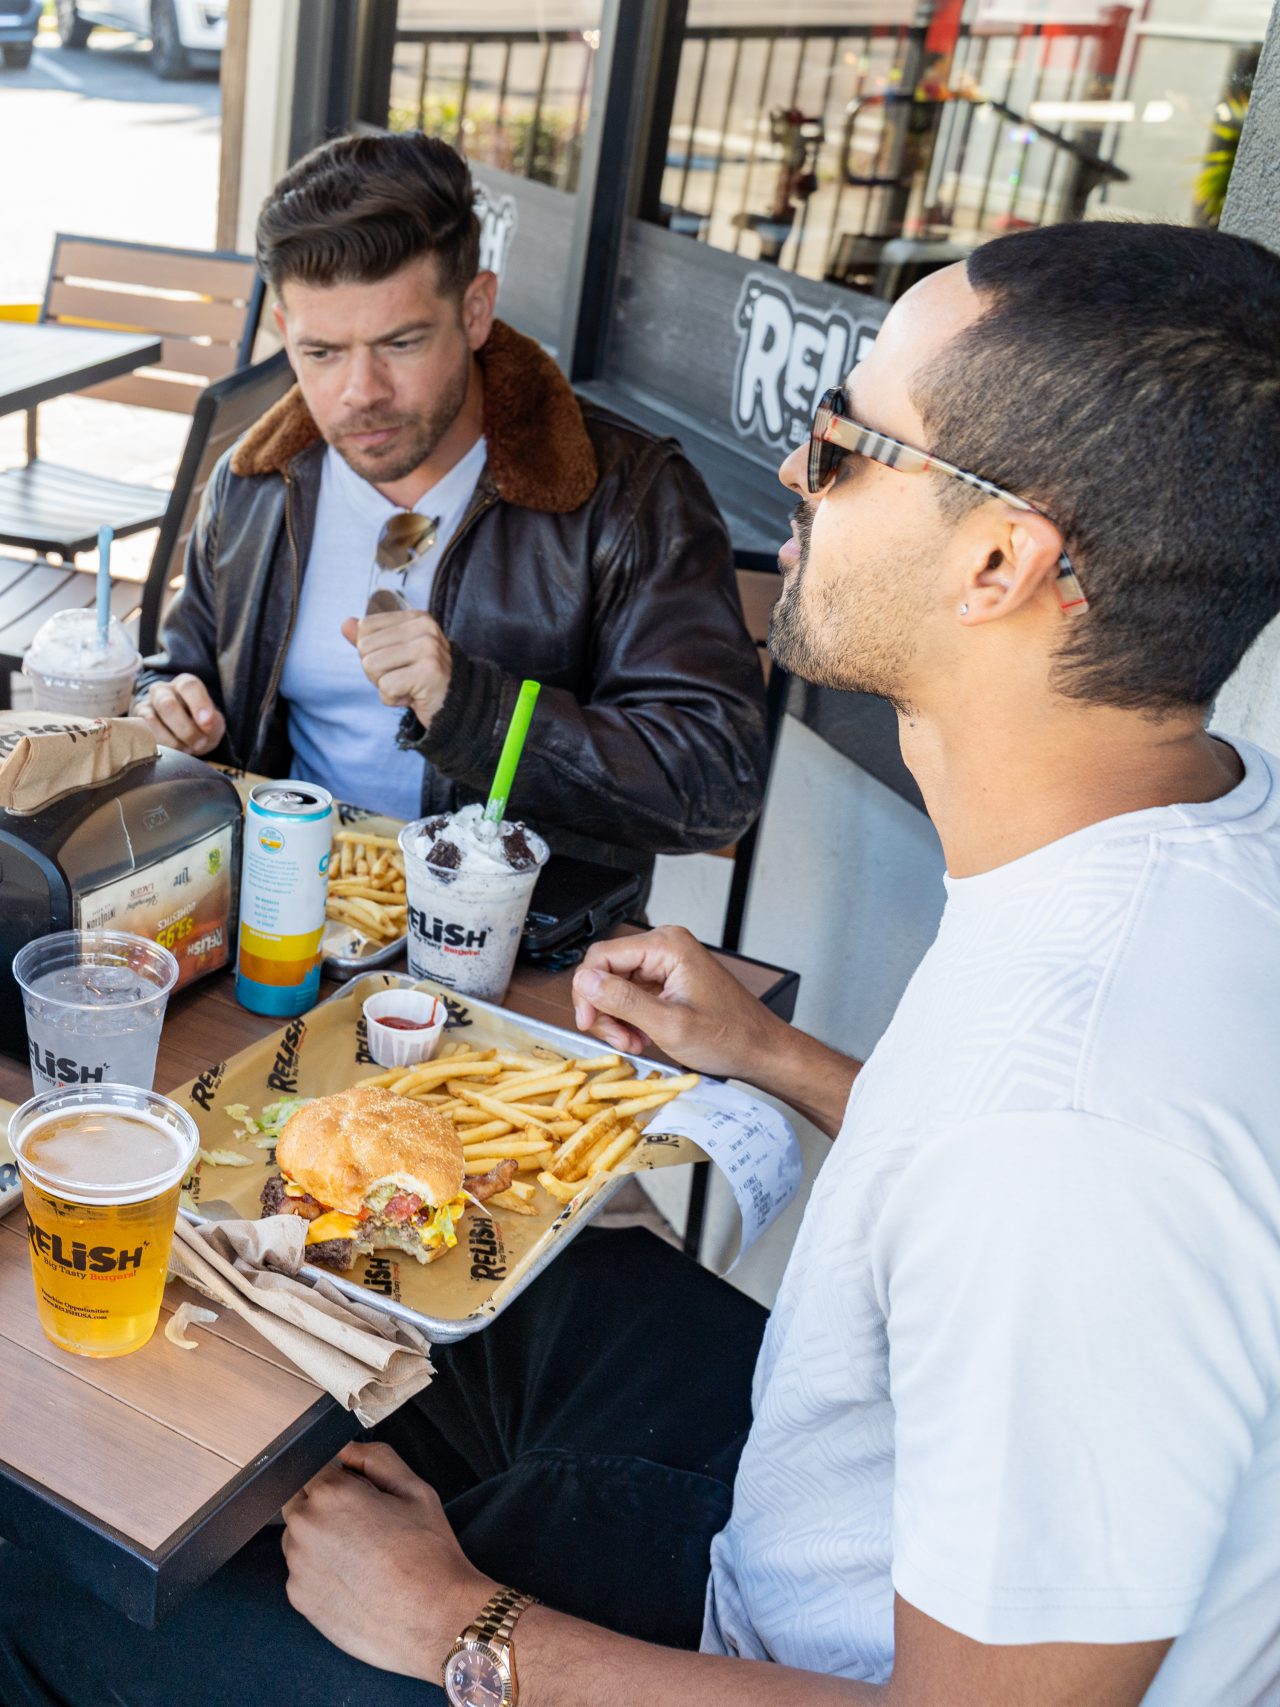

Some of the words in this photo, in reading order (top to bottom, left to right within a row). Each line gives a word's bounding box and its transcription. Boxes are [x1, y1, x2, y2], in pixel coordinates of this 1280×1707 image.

[738, 292, 876, 434] REL
[157, 902, 197, 931] DOMESTICS
[408, 905, 487, 948] ELiSH
[43, 1256, 58, 1272] Big
[58, 1265, 87, 1280] Tasty
[90, 1270, 136, 1282] Burgers!
[64, 1302, 109, 1314] Opportunities
